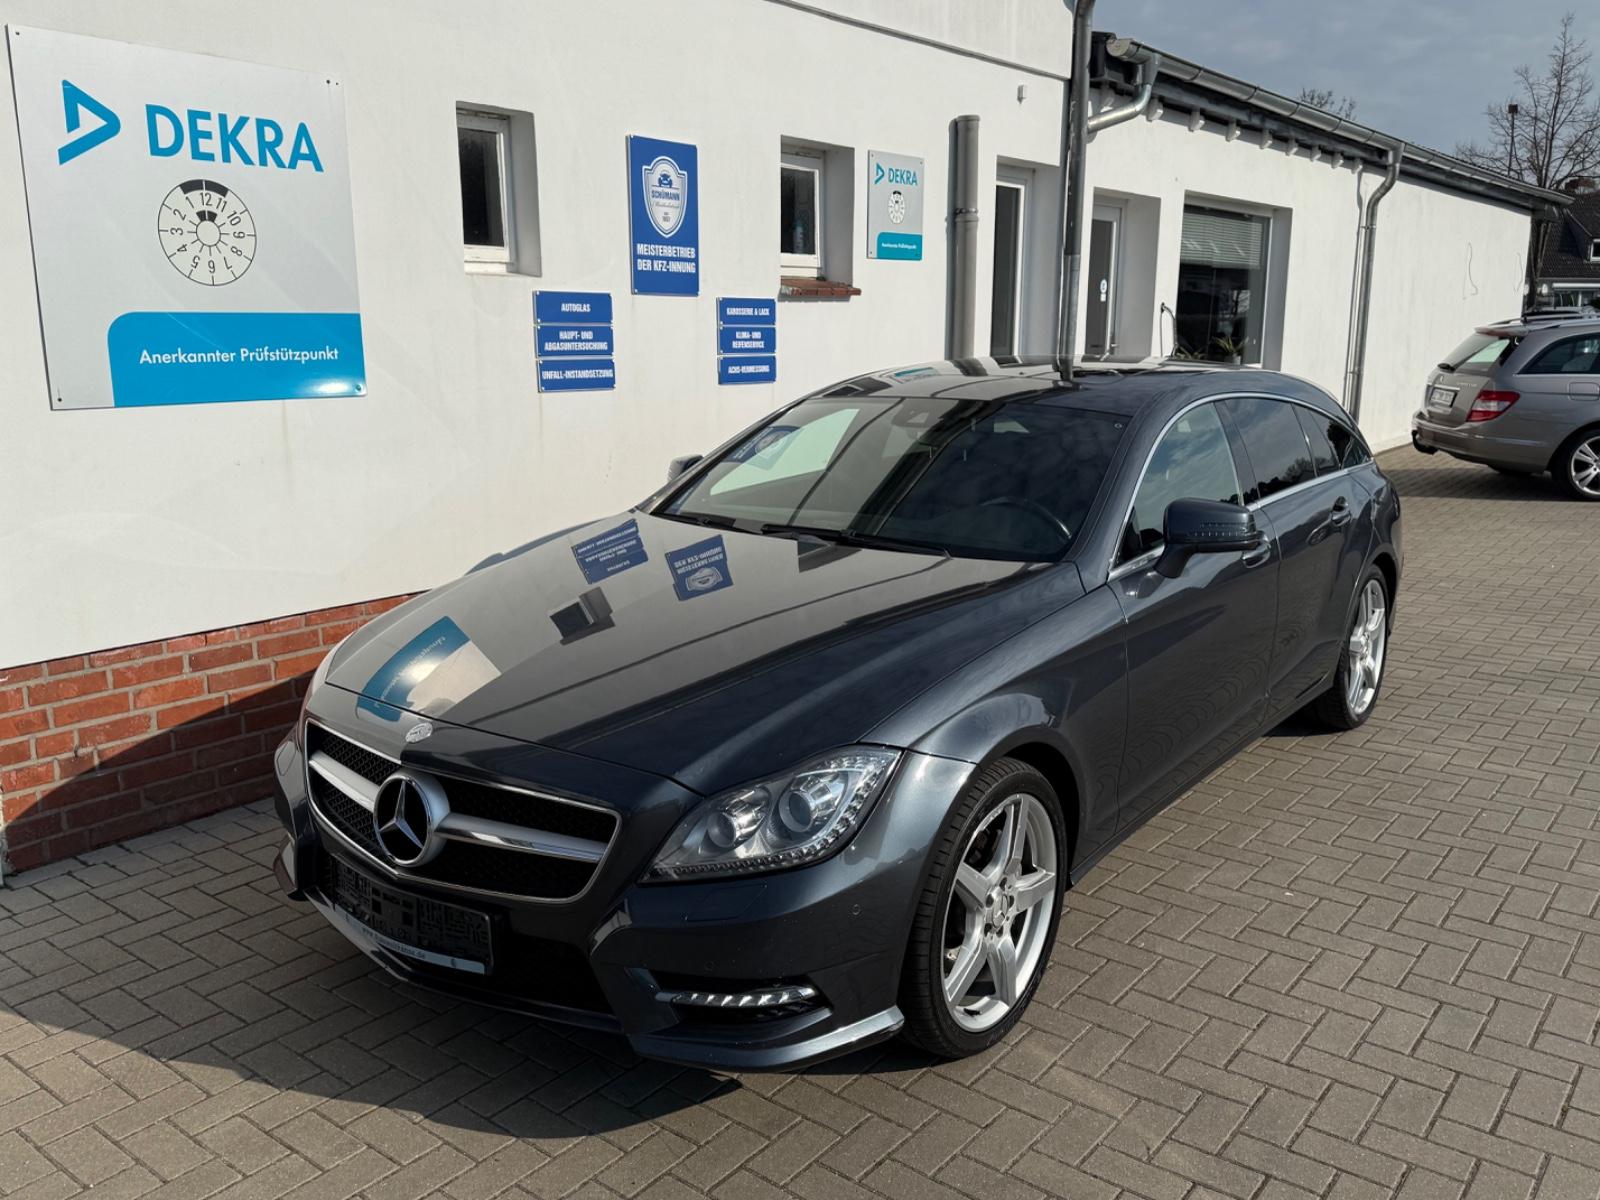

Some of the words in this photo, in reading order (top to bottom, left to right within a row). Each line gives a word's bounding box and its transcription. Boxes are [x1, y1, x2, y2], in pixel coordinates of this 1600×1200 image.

[145, 104, 324, 172] DEKRA
[888, 167, 918, 186] DEKRA
[185, 196, 195, 209] 1
[200, 192, 213, 206] 12
[216, 197, 228, 212] 11
[173, 208, 187, 221] 2
[227, 210, 242, 226] 10
[170, 227, 184, 236] 3
[177, 243, 188, 253] 4
[230, 246, 243, 257] 8
[636, 243, 696, 259] MEISTERBETRIEB
[191, 255, 201, 269] 5
[223, 256, 233, 270] 7
[637, 259, 652, 271] DER
[653, 260, 696, 273] KFZ-INNUNG
[561, 303, 591, 313] AUTOGLAS
[559, 331, 580, 340] HAUPT-
[581, 331, 593, 340] UND
[544, 341, 608, 351] ABGASUNTERSUCHUNG
[139, 348, 236, 365] Anerkannter
[240, 346, 339, 364] Prüfstützpunkt
[541, 369, 614, 380] UNFALL-INSTANDSETZUNG
